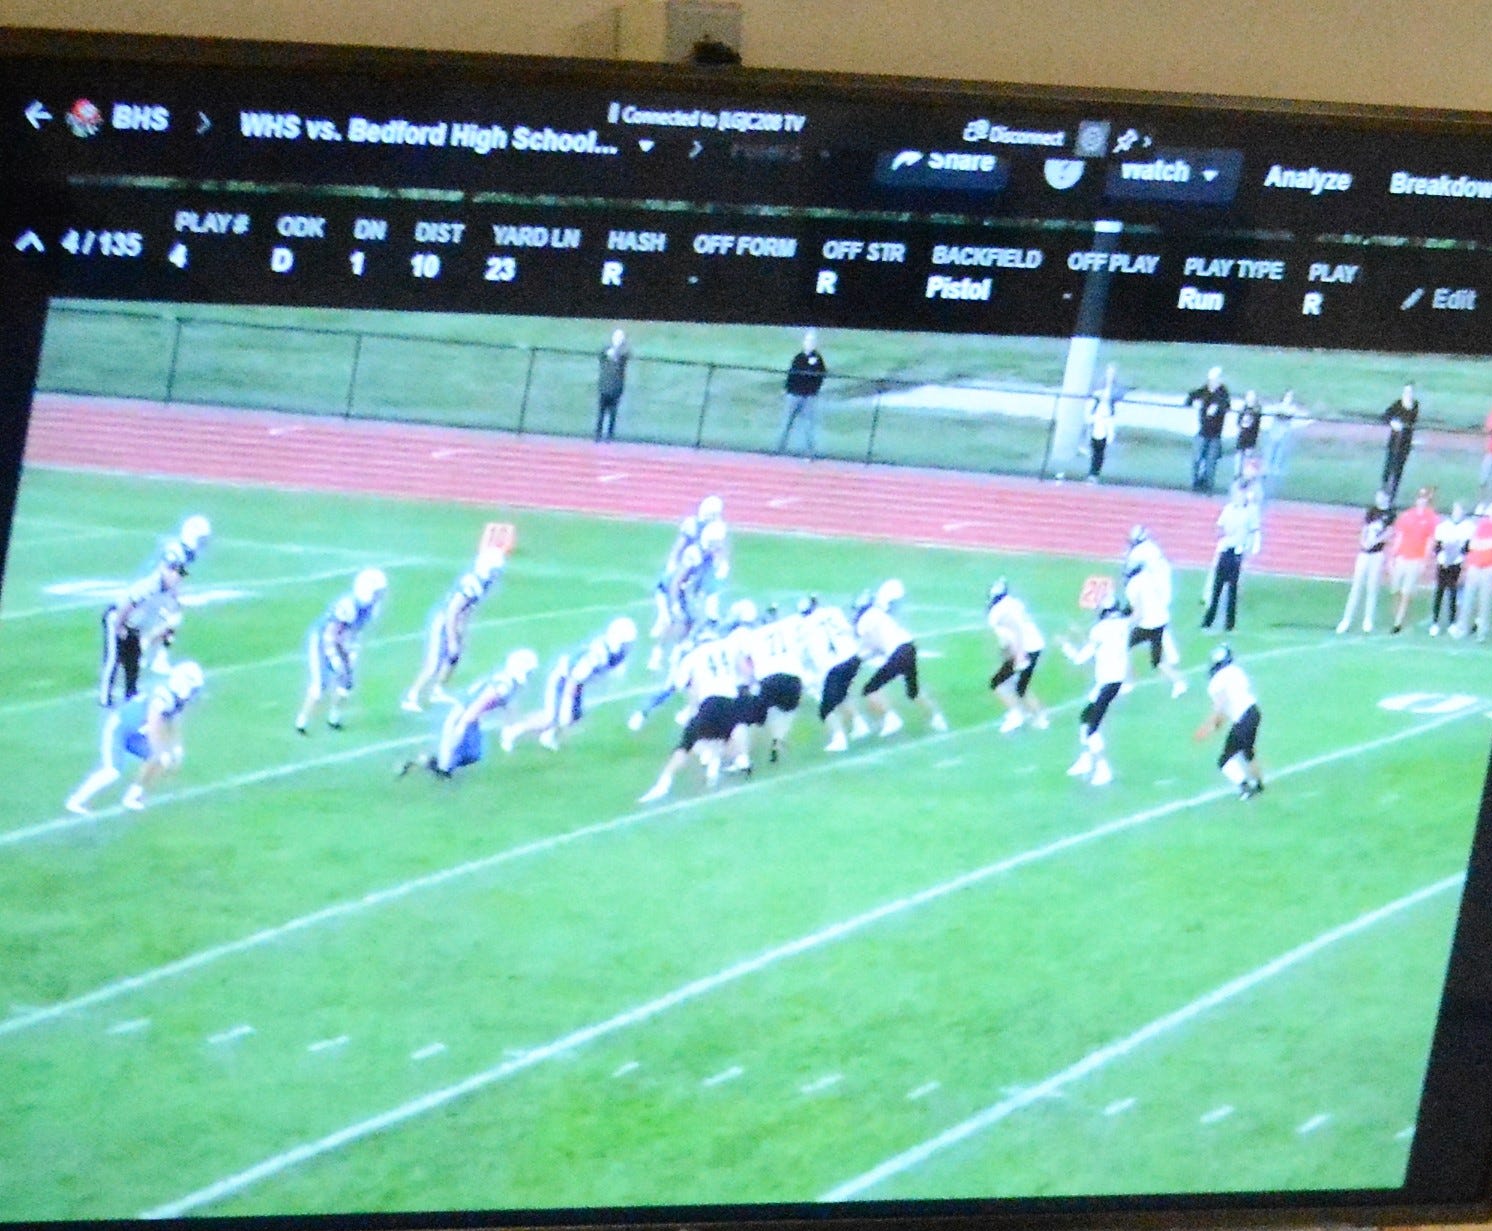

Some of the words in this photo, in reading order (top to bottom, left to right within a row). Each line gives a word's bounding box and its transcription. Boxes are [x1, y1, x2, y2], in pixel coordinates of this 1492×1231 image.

[111, 102, 171, 131] BHS
[240, 111, 302, 139] WHS
[305, 119, 342, 141] vs.
[348, 116, 448, 147] Bedford
[450, 122, 508, 154] High
[989, 125, 1066, 147] Disconnect
[1264, 165, 1353, 195] Analyze
[174, 210, 231, 233] PLAY
[276, 215, 327, 239] ODK
[353, 219, 388, 241] DN
[414, 221, 465, 244] DIST
[493, 223, 549, 247] YARD
[551, 227, 581, 248] LN
[606, 229, 668, 252] HASH
[693, 233, 735, 255] OFF
[736, 236, 798, 258] FORM
[168, 241, 188, 269] 4
[270, 246, 293, 273] D
[350, 250, 364, 276] 1
[822, 240, 863, 261] OFF
[866, 242, 906, 263] STR
[931, 245, 1043, 269] BACKFIELD
[1067, 251, 1107, 272] OFF
[1108, 253, 1160, 275] PLAY
[410, 252, 441, 279] 10
[484, 256, 516, 281] 23
[601, 261, 624, 287] R
[1183, 256, 1234, 278] PLAY
[1237, 259, 1286, 280] TYPE
[1308, 263, 1360, 284] PLAY
[816, 270, 838, 295] R
[926, 275, 993, 301] Pistol
[1177, 286, 1225, 311] Run
[1302, 292, 1323, 316] R
[1432, 288, 1476, 311] Edit
